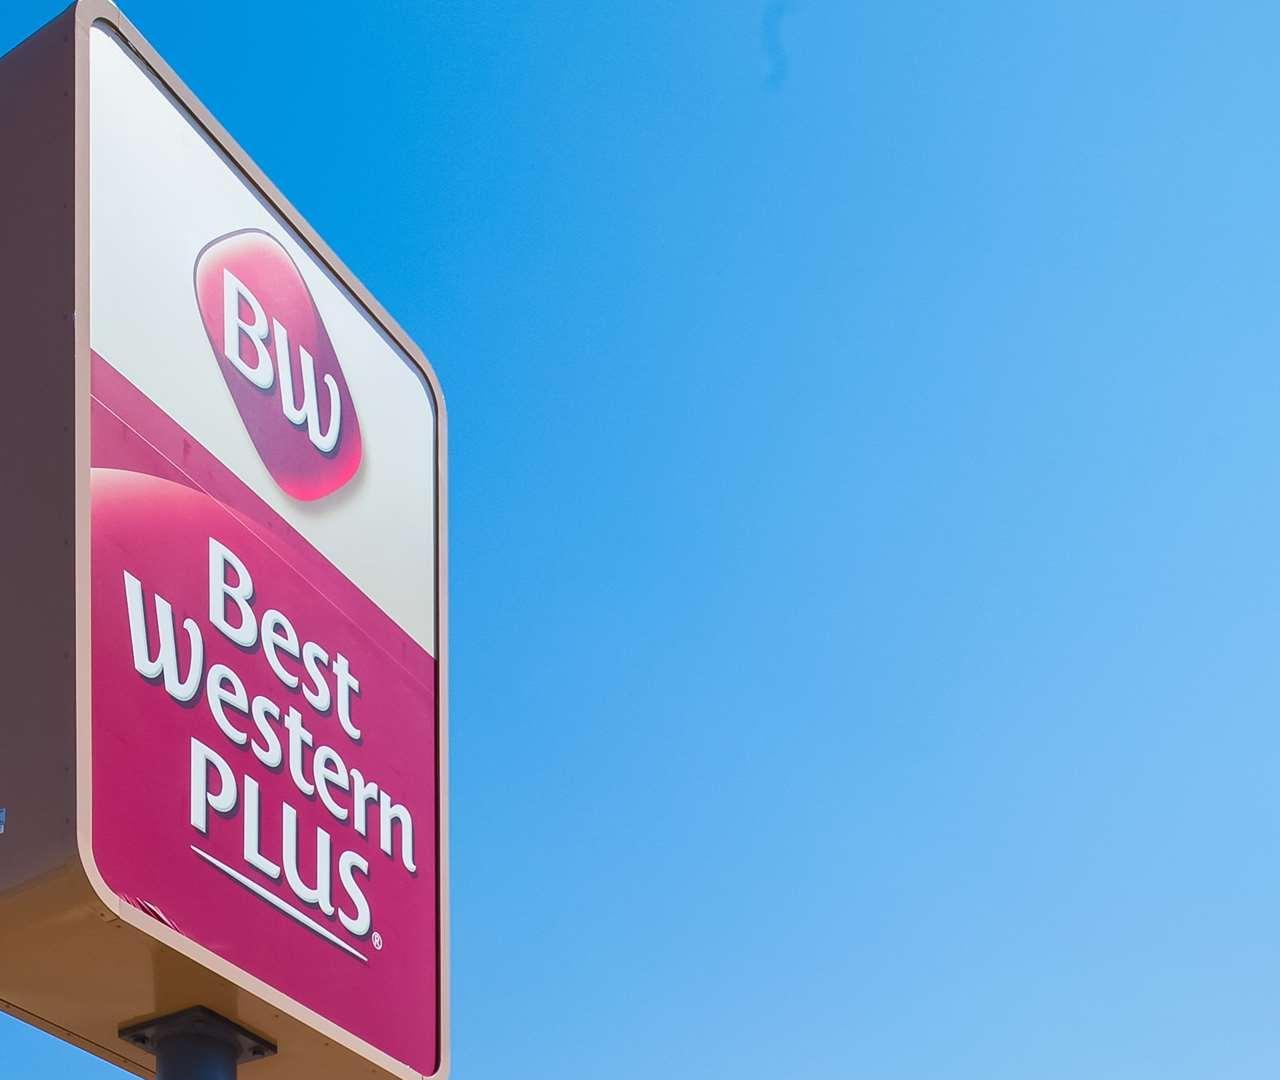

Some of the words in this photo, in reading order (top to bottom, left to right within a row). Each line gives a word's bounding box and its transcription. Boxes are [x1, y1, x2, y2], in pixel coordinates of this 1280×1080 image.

[223, 267, 341, 453] BW
[122, 569, 417, 874] Western
[209, 537, 361, 739] Best
[190, 736, 371, 937] PLUS
